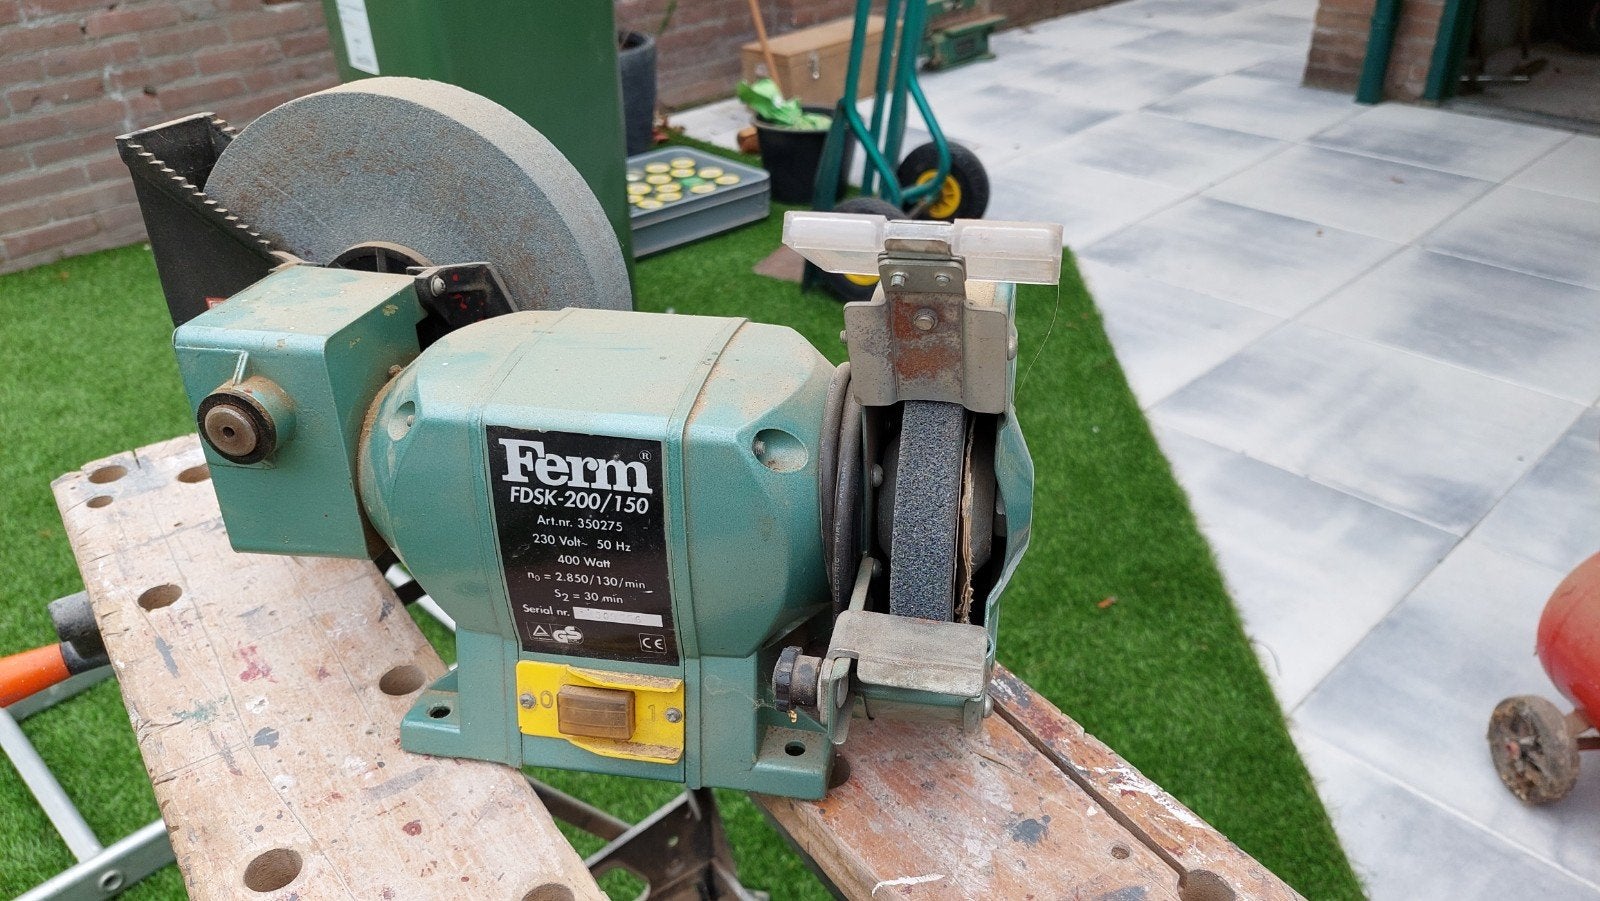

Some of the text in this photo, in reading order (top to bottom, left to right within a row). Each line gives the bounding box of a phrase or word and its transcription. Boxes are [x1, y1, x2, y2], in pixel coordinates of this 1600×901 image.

[498, 438, 653, 495] Ferm
[510, 486, 649, 515] FDSK-200/150
[536, 514, 623, 532] Art.nr. 350275
[532, 533, 556, 546] 230
[597, 539, 612, 550] 50
[616, 541, 632, 552] Hz
[557, 554, 611, 568] 400 Watt
[555, 571, 646, 589] 2.850/130/min
[584, 591, 599, 601] 30
[602, 593, 624, 604] min
[522, 603, 553, 616] Serial
[556, 608, 571, 617] nr.
[642, 637, 664, 650] CE
